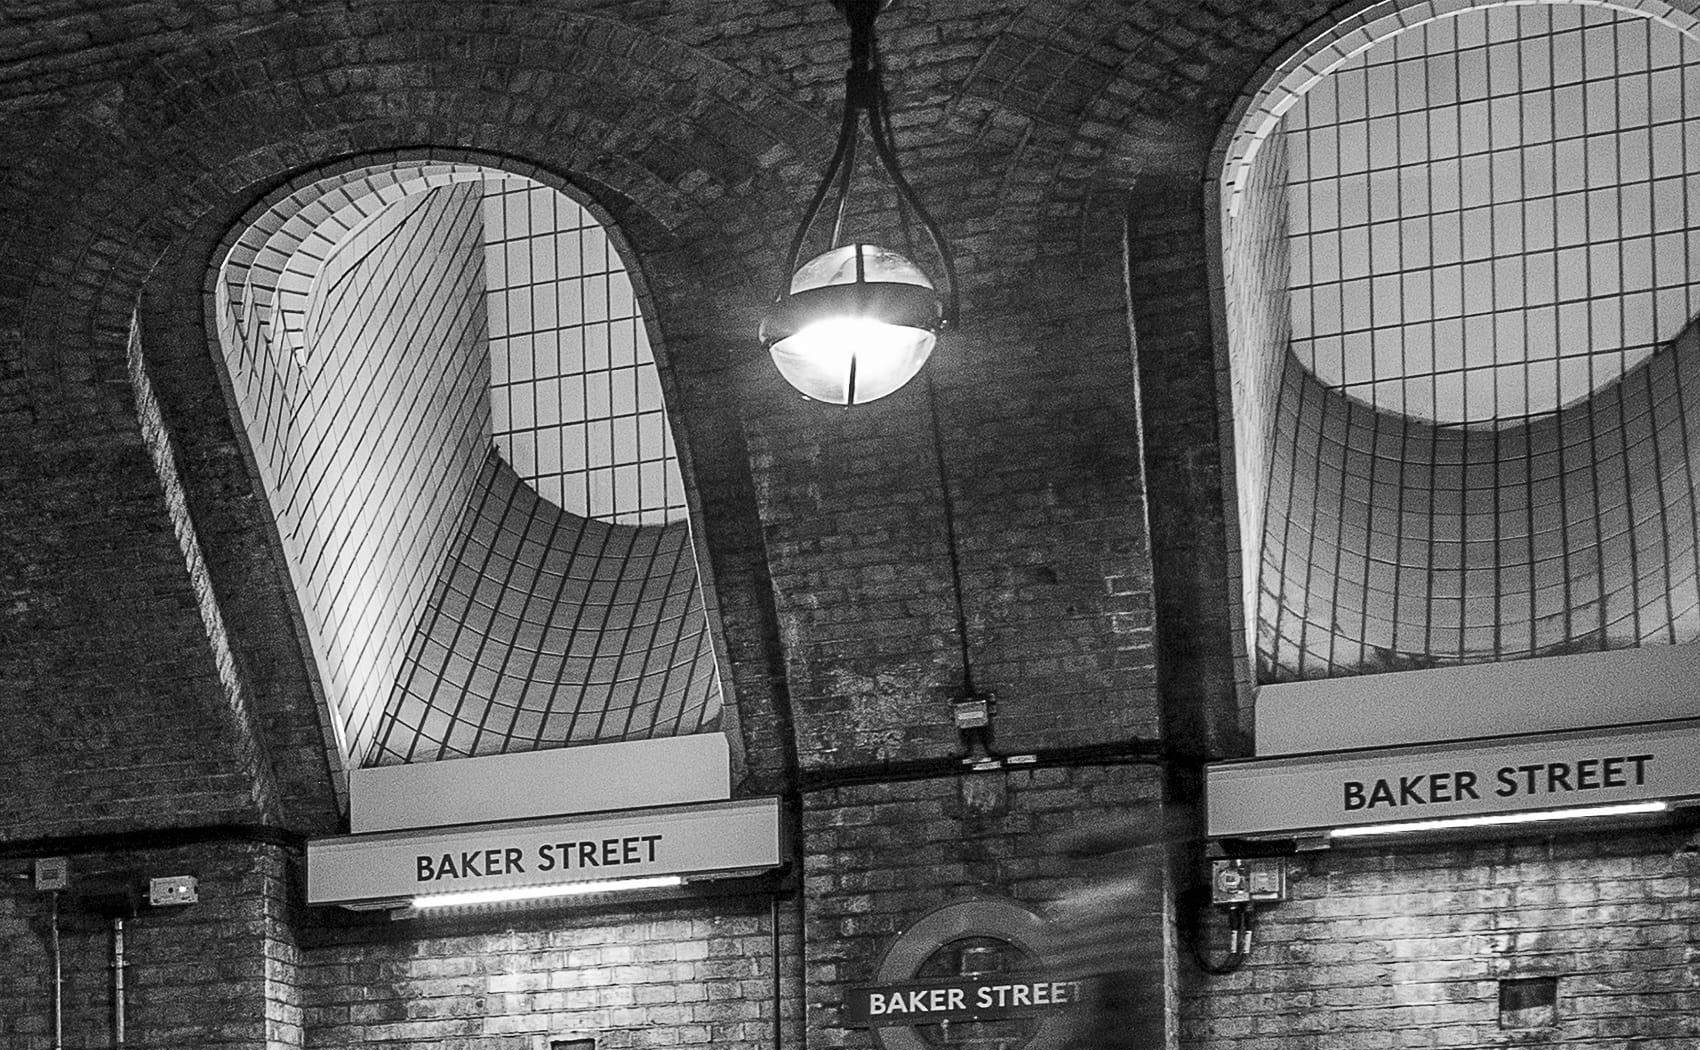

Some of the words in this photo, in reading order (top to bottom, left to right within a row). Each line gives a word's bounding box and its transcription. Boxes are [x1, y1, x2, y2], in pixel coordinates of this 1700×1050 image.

[1343, 771, 1480, 811] BAKER
[1494, 754, 1654, 797] STREET
[416, 848, 525, 882] BAKER
[537, 835, 662, 871] STREET
[869, 988, 967, 1015] BAKER
[975, 981, 1082, 1009] STREET
